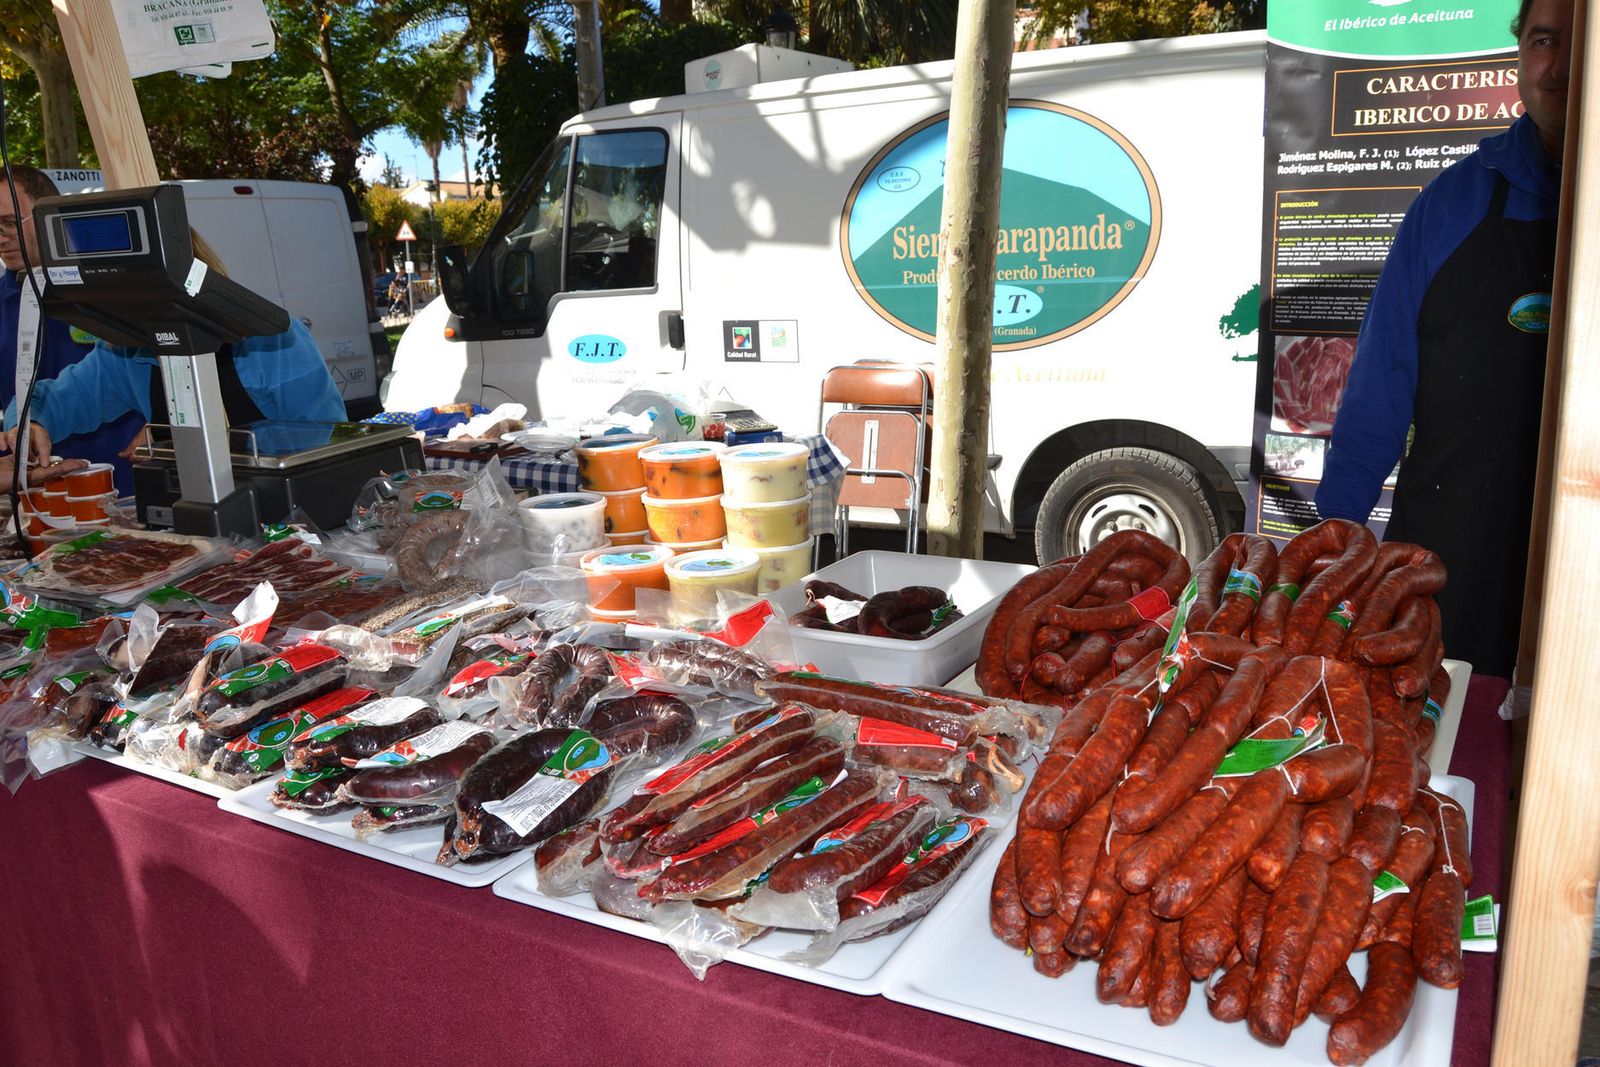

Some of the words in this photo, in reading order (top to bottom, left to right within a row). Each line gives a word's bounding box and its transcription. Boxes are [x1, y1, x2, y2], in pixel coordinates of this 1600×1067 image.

[1324, 20, 1337, 32] El
[1339, 16, 1387, 31] Ibérico
[1389, 13, 1406, 26] de
[1408, 8, 1474, 25] Aceituna
[1366, 68, 1519, 95] CARACTERIS
[1354, 104, 1450, 127] IBERICO
[1456, 102, 1489, 121] DE
[1493, 100, 1527, 120] AC
[1278, 152, 1317, 164] Jiménez
[1319, 149, 1356, 161] Molina,
[1405, 145, 1439, 159] López
[1440, 143, 1480, 155] Castill
[1326, 161, 1378, 175] Espigares
[1415, 159, 1439, 169] Ruiz
[56, 171, 101, 182] ZANOTTI
[893, 225, 941, 261] Sier
[996, 214, 1123, 262] arapanda
[1042, 263, 1096, 280] Ibérico
[155, 332, 180, 342] DIBAL
[994, 326, 1037, 337] (Granada)
[575, 342, 623, 357] F.J.T.
